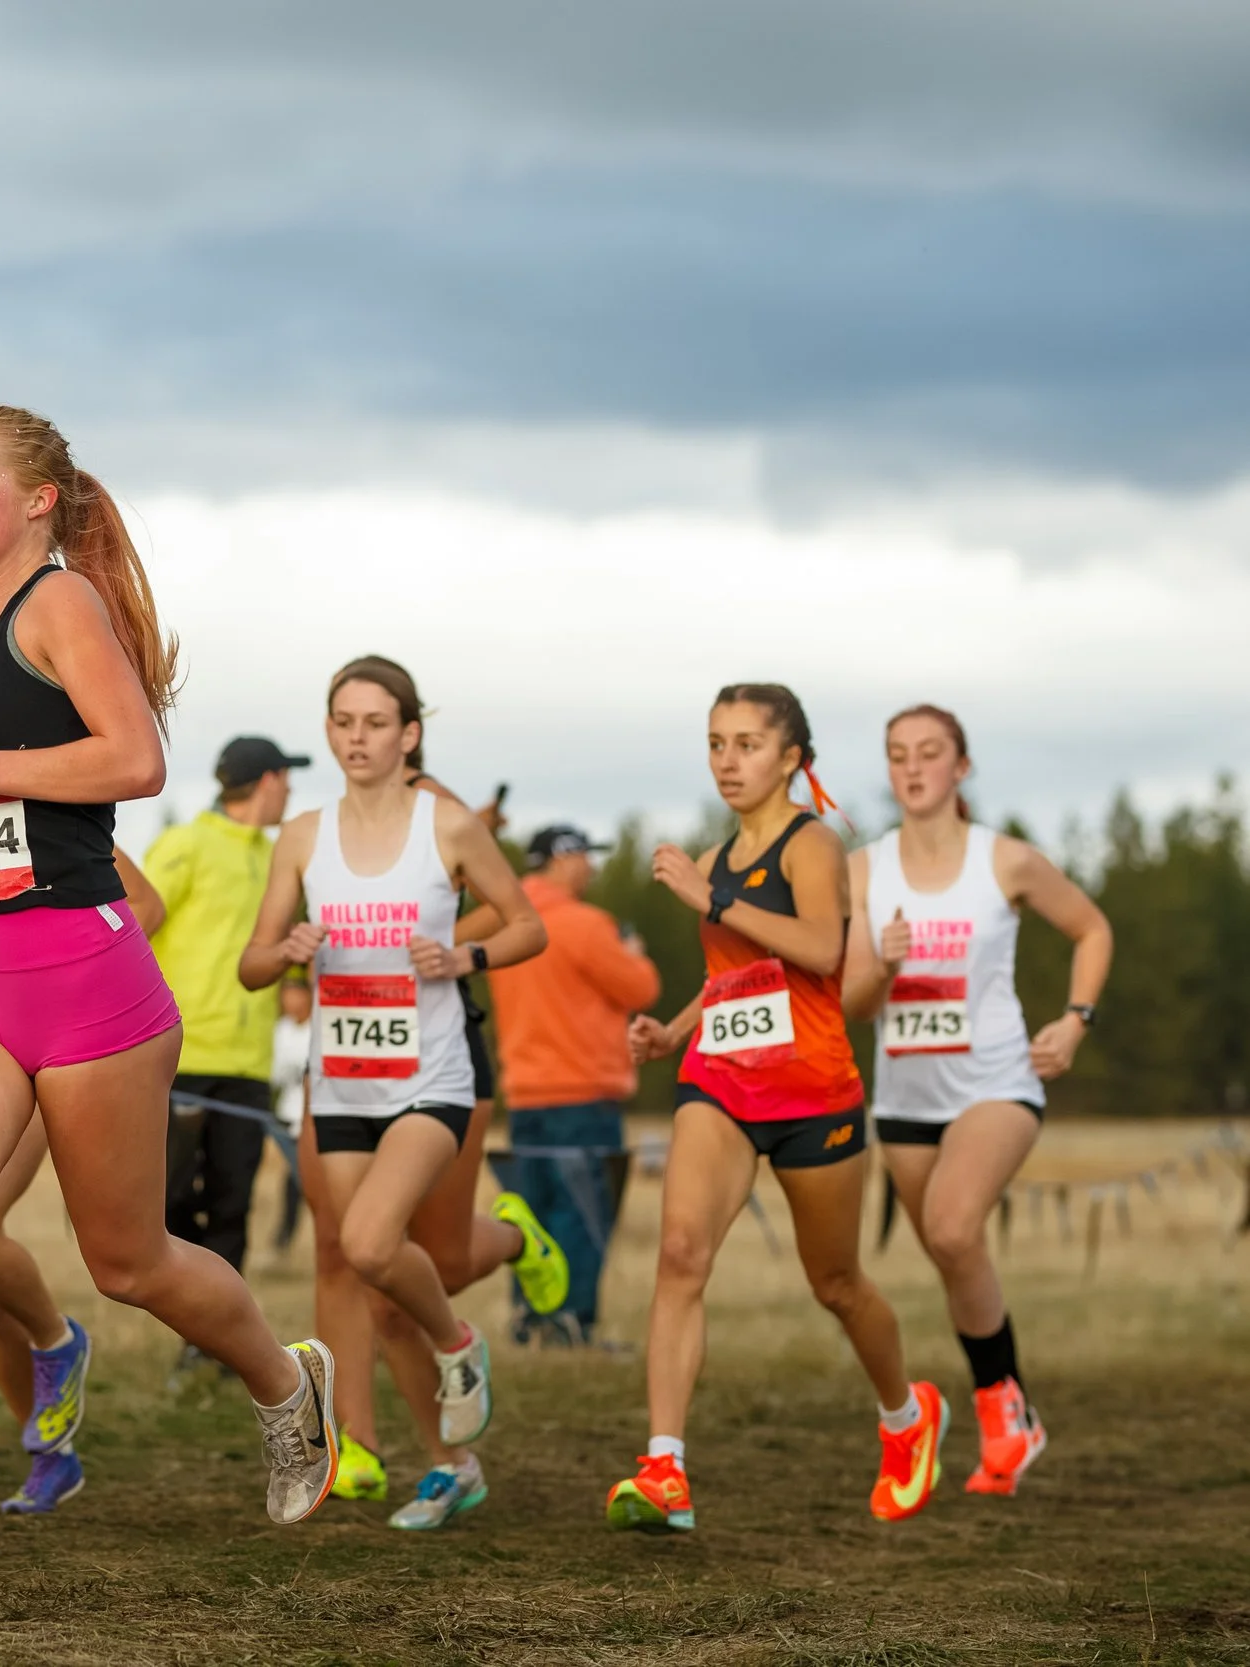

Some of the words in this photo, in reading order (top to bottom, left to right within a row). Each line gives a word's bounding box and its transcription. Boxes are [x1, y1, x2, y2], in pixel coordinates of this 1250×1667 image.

[321, 902, 419, 924] MILLTOWN
[329, 927, 413, 948] PROJECT
[331, 1017, 409, 1047] 1745
[713, 1006, 774, 1042] 663
[896, 1011, 962, 1037] 1743
